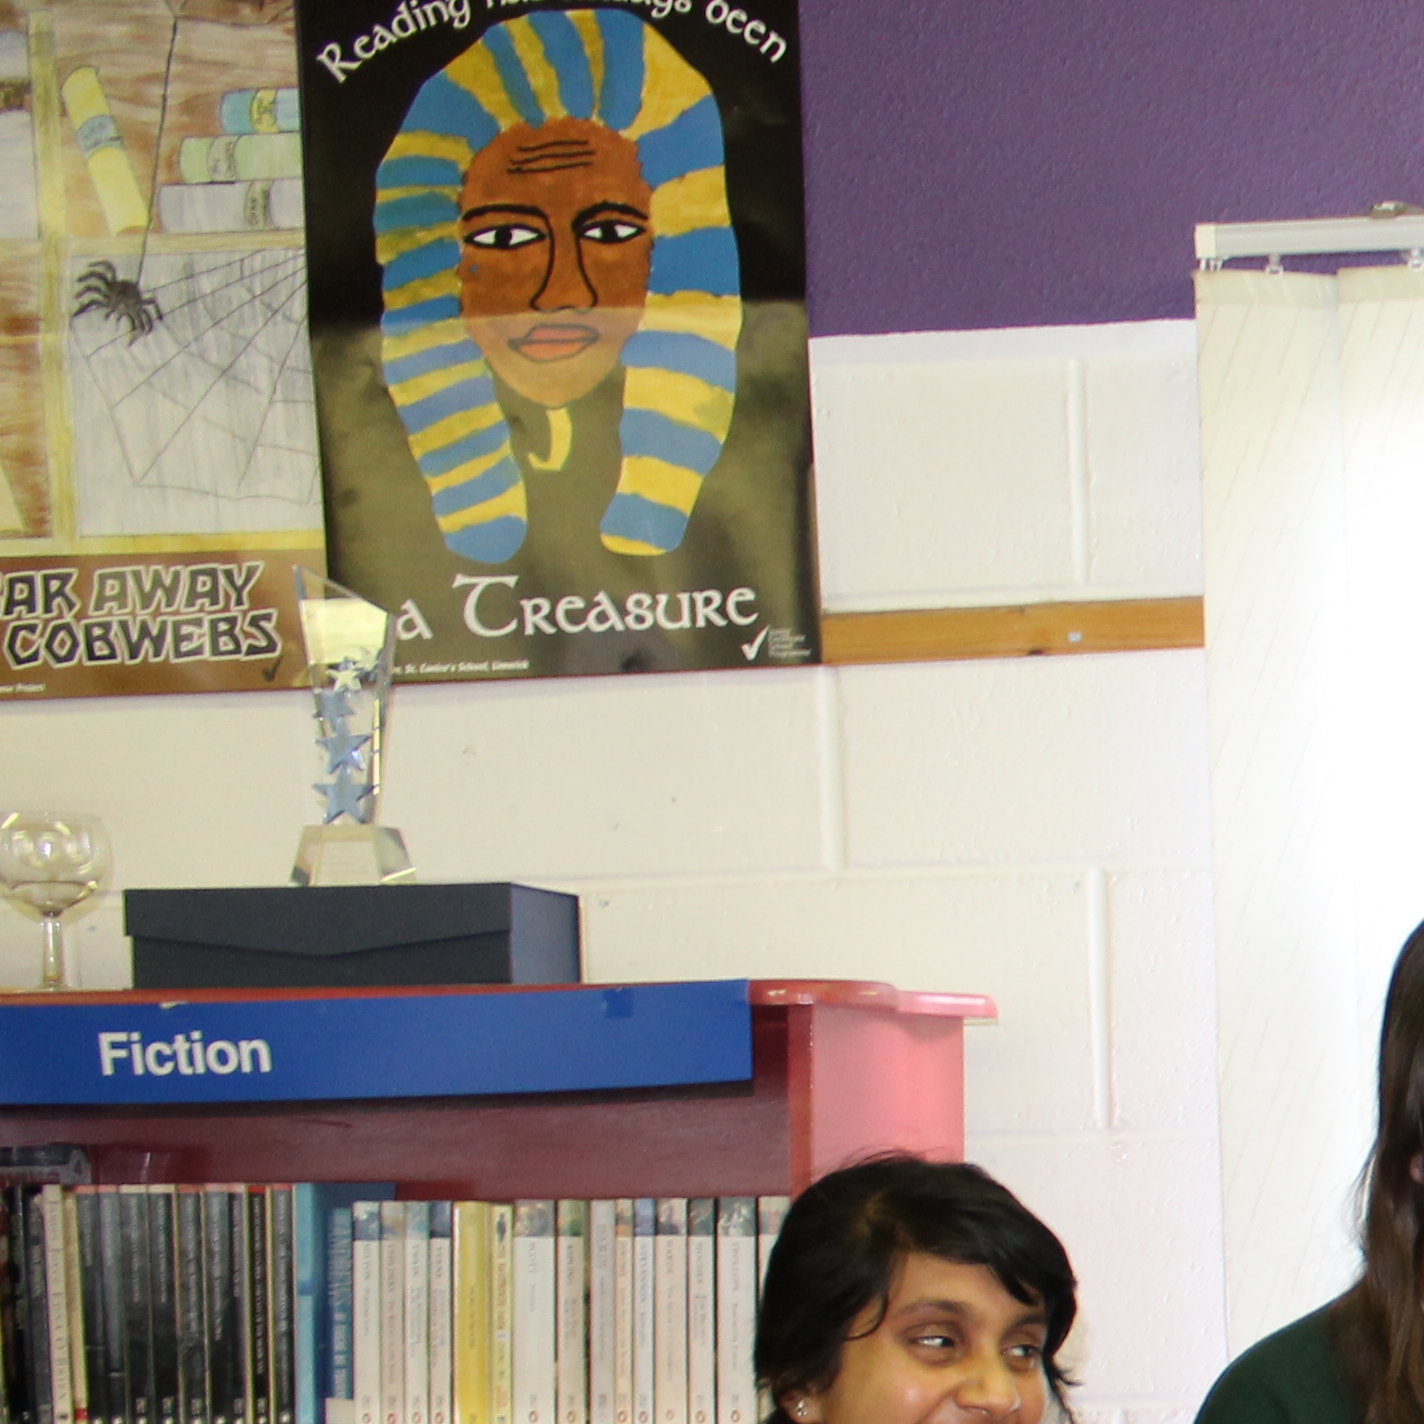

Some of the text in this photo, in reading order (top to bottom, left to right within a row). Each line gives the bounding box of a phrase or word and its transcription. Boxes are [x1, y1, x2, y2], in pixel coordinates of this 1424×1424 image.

[316, 0, 474, 83] Reading
[0, 561, 265, 620] AR AWAY
[3, 608, 284, 671] COBWEBS
[97, 1029, 273, 1077] Fiction
